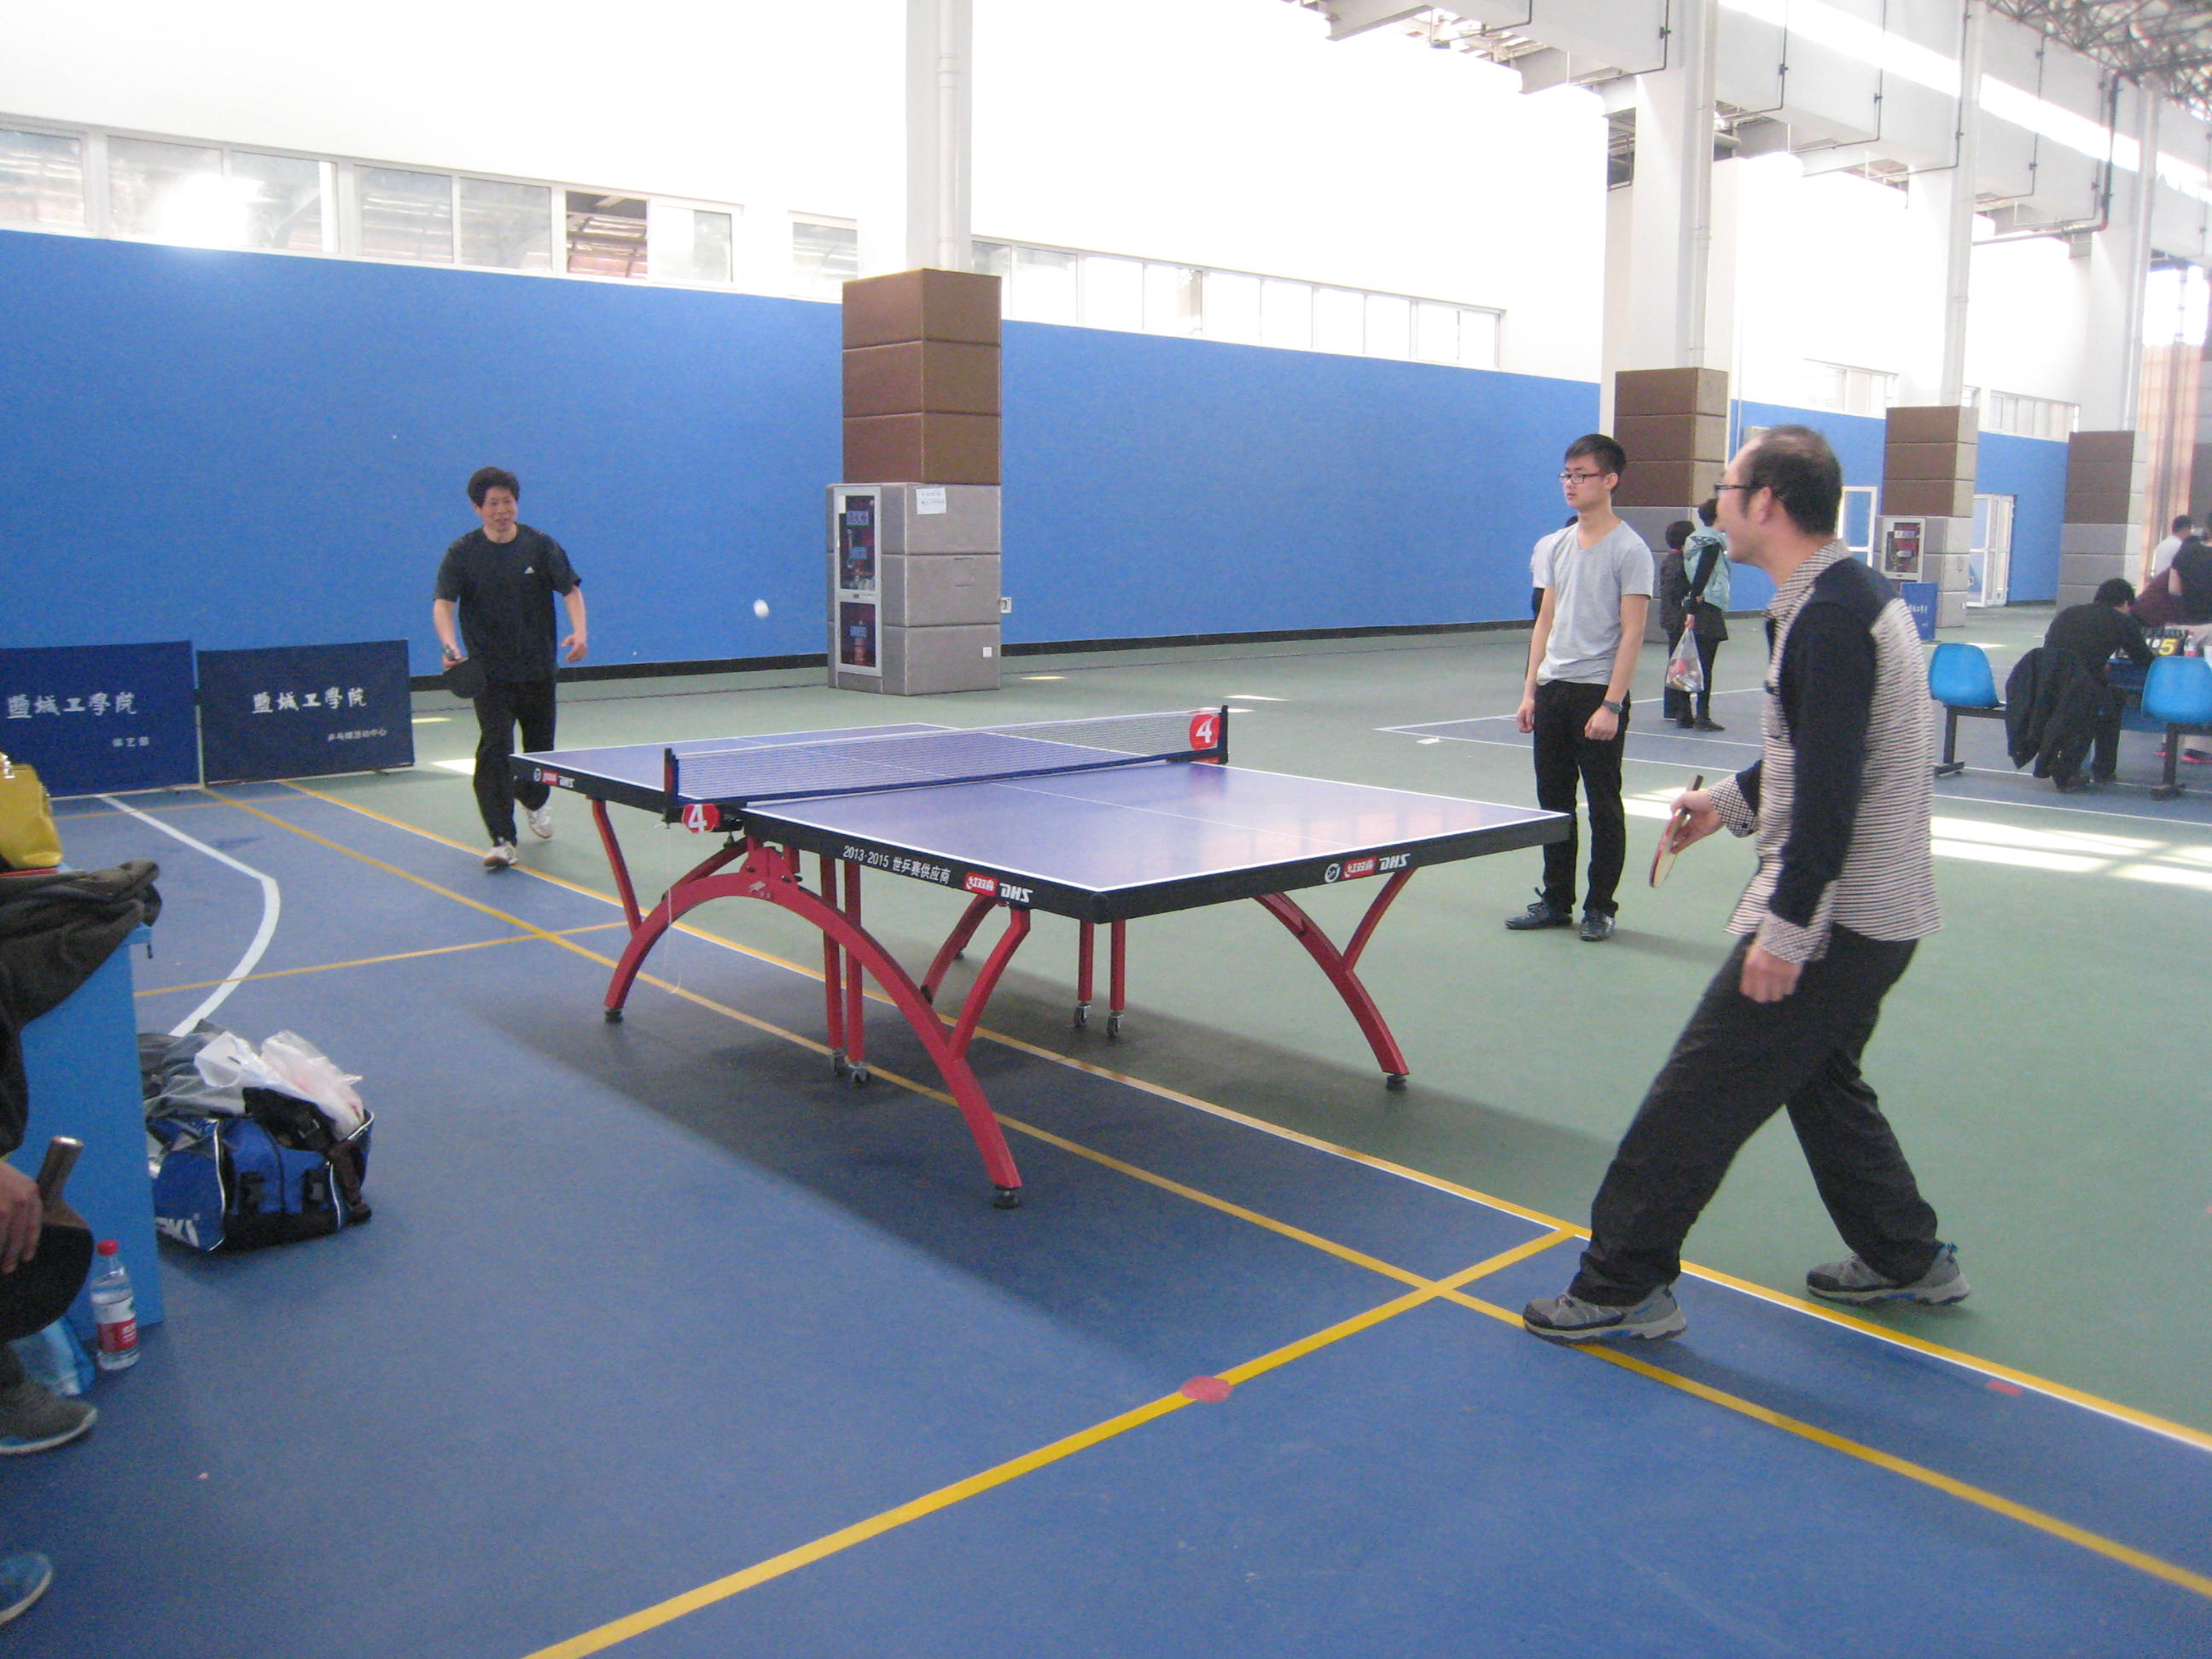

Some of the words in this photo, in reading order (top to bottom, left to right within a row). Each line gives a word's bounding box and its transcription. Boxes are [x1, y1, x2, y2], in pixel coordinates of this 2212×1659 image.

[1196, 717, 1213, 743] 4
[688, 804, 707, 834] 4
[893, 856, 952, 885] 世乒赛供应商
[1379, 853, 1411, 870] DHS
[999, 882, 1033, 904] DHS
